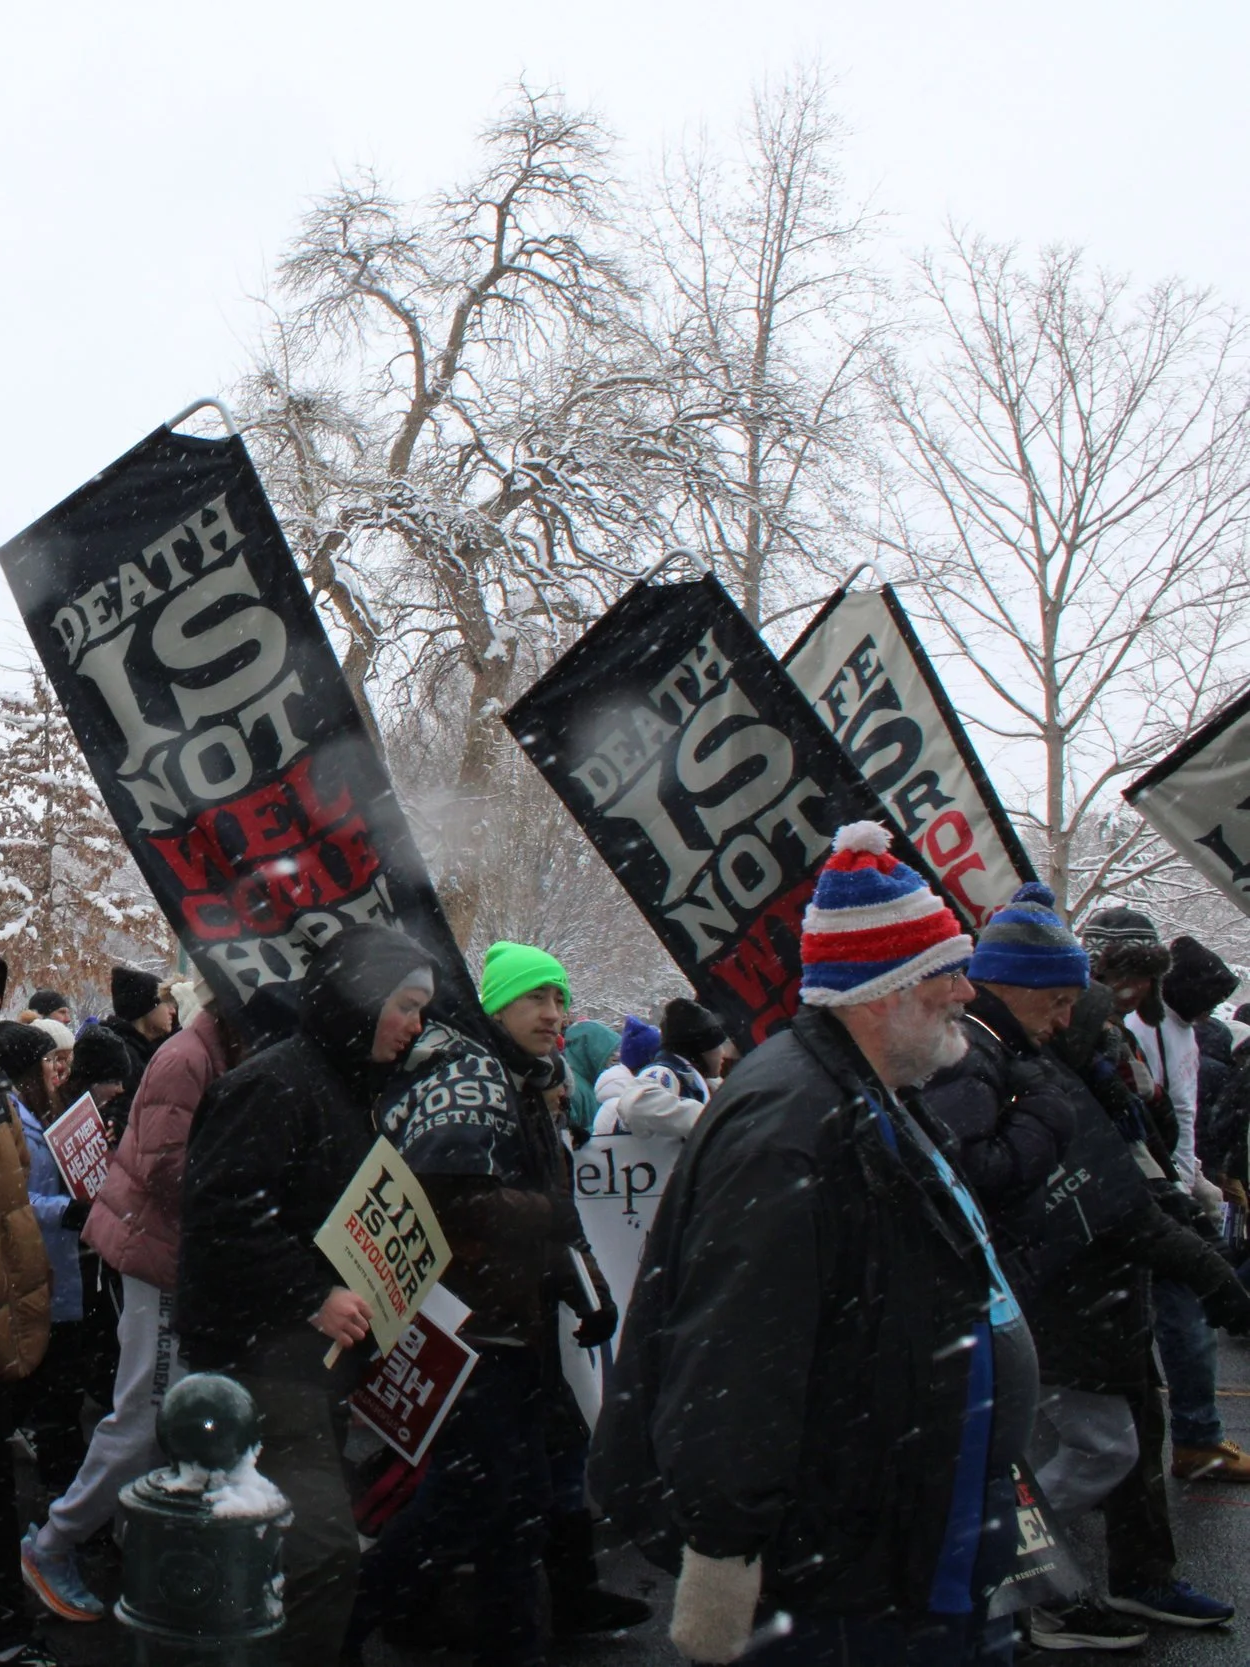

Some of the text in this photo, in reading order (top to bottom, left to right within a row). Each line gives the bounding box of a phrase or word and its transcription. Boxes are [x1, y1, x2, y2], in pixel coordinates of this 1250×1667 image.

[50, 491, 246, 665] DEATH
[76, 552, 288, 776] IS
[569, 626, 732, 809] DEATH
[808, 633, 885, 735] FE
[117, 669, 309, 833] NOT
[603, 676, 795, 907] IS
[148, 755, 356, 892] WEL
[181, 813, 381, 942] COME
[663, 775, 840, 965] NOT
[60, 1136, 77, 1161] LET
[73, 1117, 98, 1143] THEIR
[66, 1131, 108, 1185] HEARTS
[82, 1157, 108, 1200] BEAT
[576, 1147, 657, 1215] elp
[354, 1193, 386, 1237] IS
[384, 1235, 419, 1305] OUR
[367, 1164, 437, 1283] LIFE
[366, 1375, 415, 1423] LET
